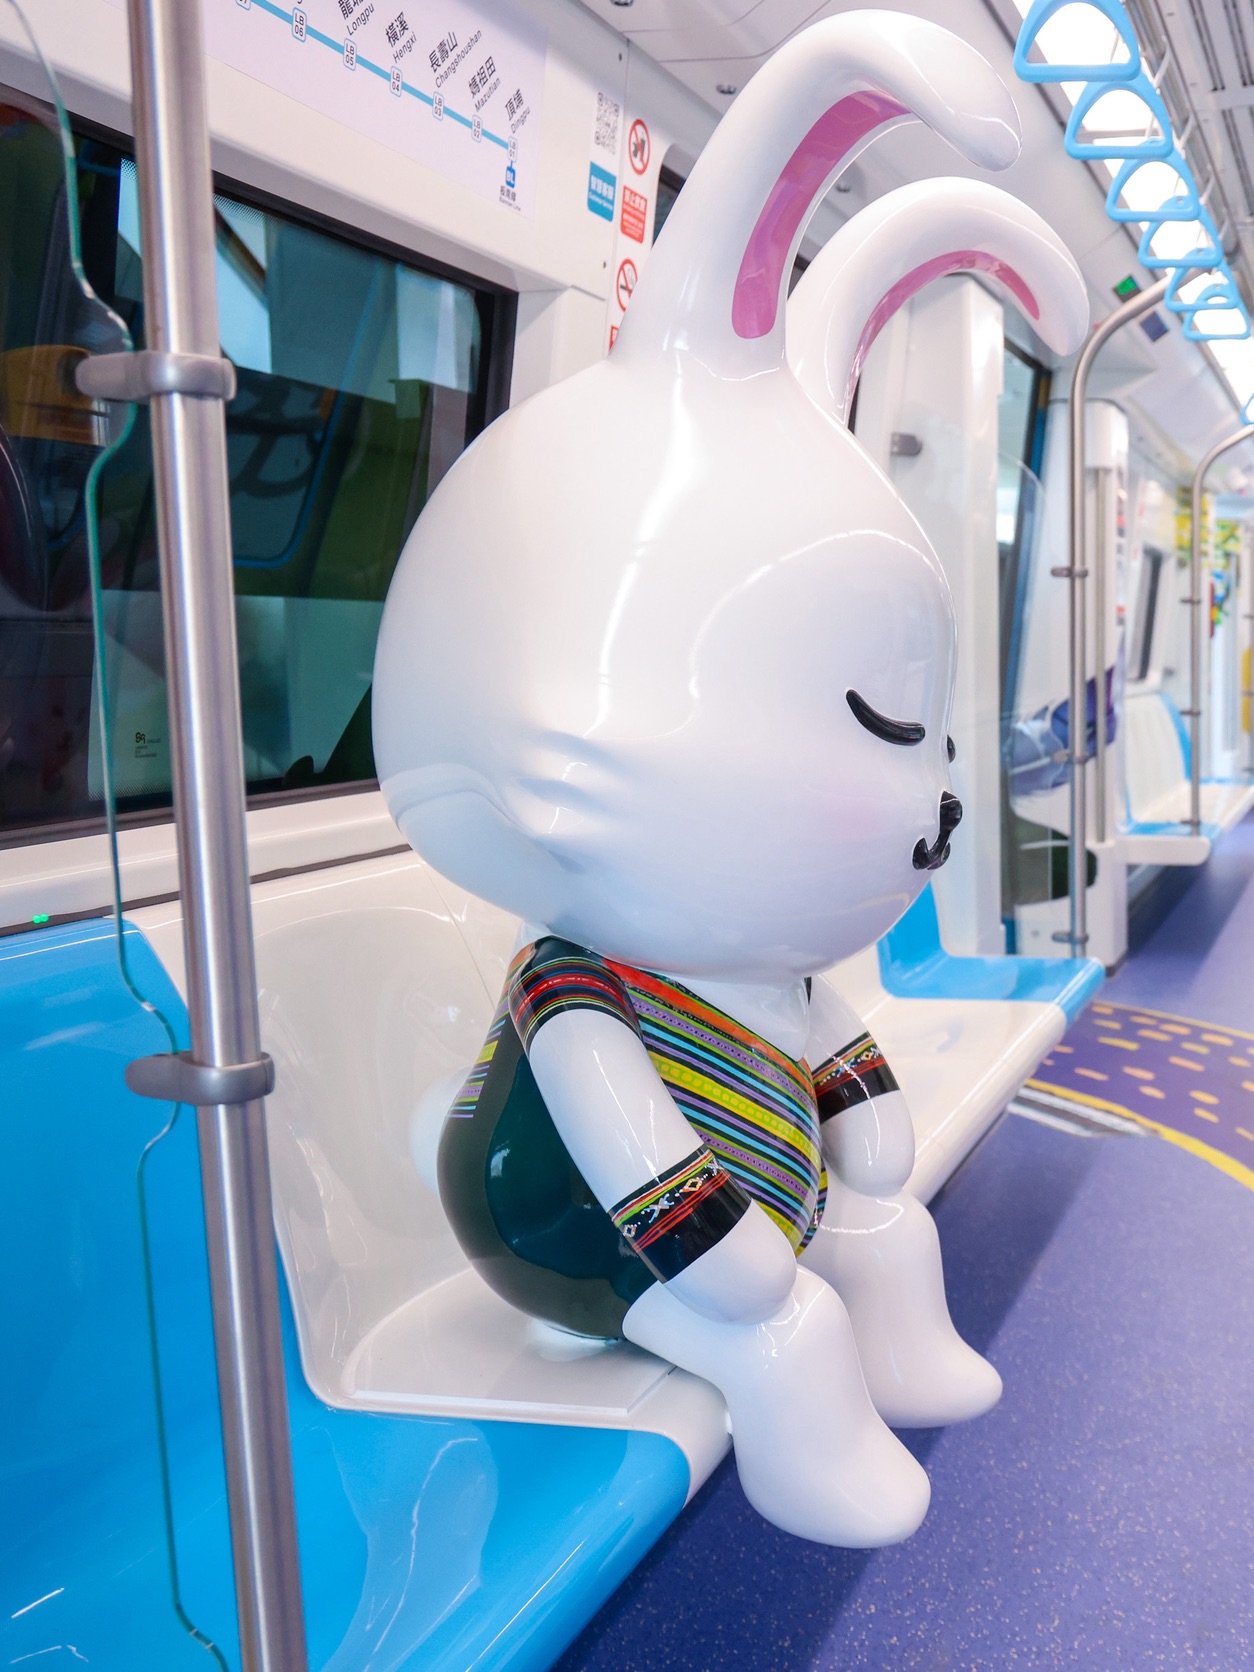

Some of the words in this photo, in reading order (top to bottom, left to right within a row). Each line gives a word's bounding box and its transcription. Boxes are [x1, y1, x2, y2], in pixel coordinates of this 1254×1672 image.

[295, 12, 304, 26] LB
[346, 3, 375, 36] Longpu
[294, 24, 304, 37] 06
[385, 11, 409, 48] 橫溪
[345, 43, 355, 56] LB
[392, 31, 417, 64] Hengxi
[428, 31, 459, 73] 長壽山
[344, 54, 354, 66] 05
[435, 29, 483, 88] Changshoushan
[392, 70, 401, 83] LB
[468, 56, 496, 99] 媽祖田
[391, 80, 400, 93] 04
[434, 95, 443, 108] LB
[474, 78, 501, 113] Mazutian
[434, 105, 442, 117] 03
[505, 88, 524, 121] 頂埔
[473, 118, 481, 130] LB
[510, 106, 531, 134] Dingpu
[473, 128, 481, 139] 02
[509, 140, 517, 151] LB
[509, 148, 516, 159] 01
[506, 169, 515, 186] BL
